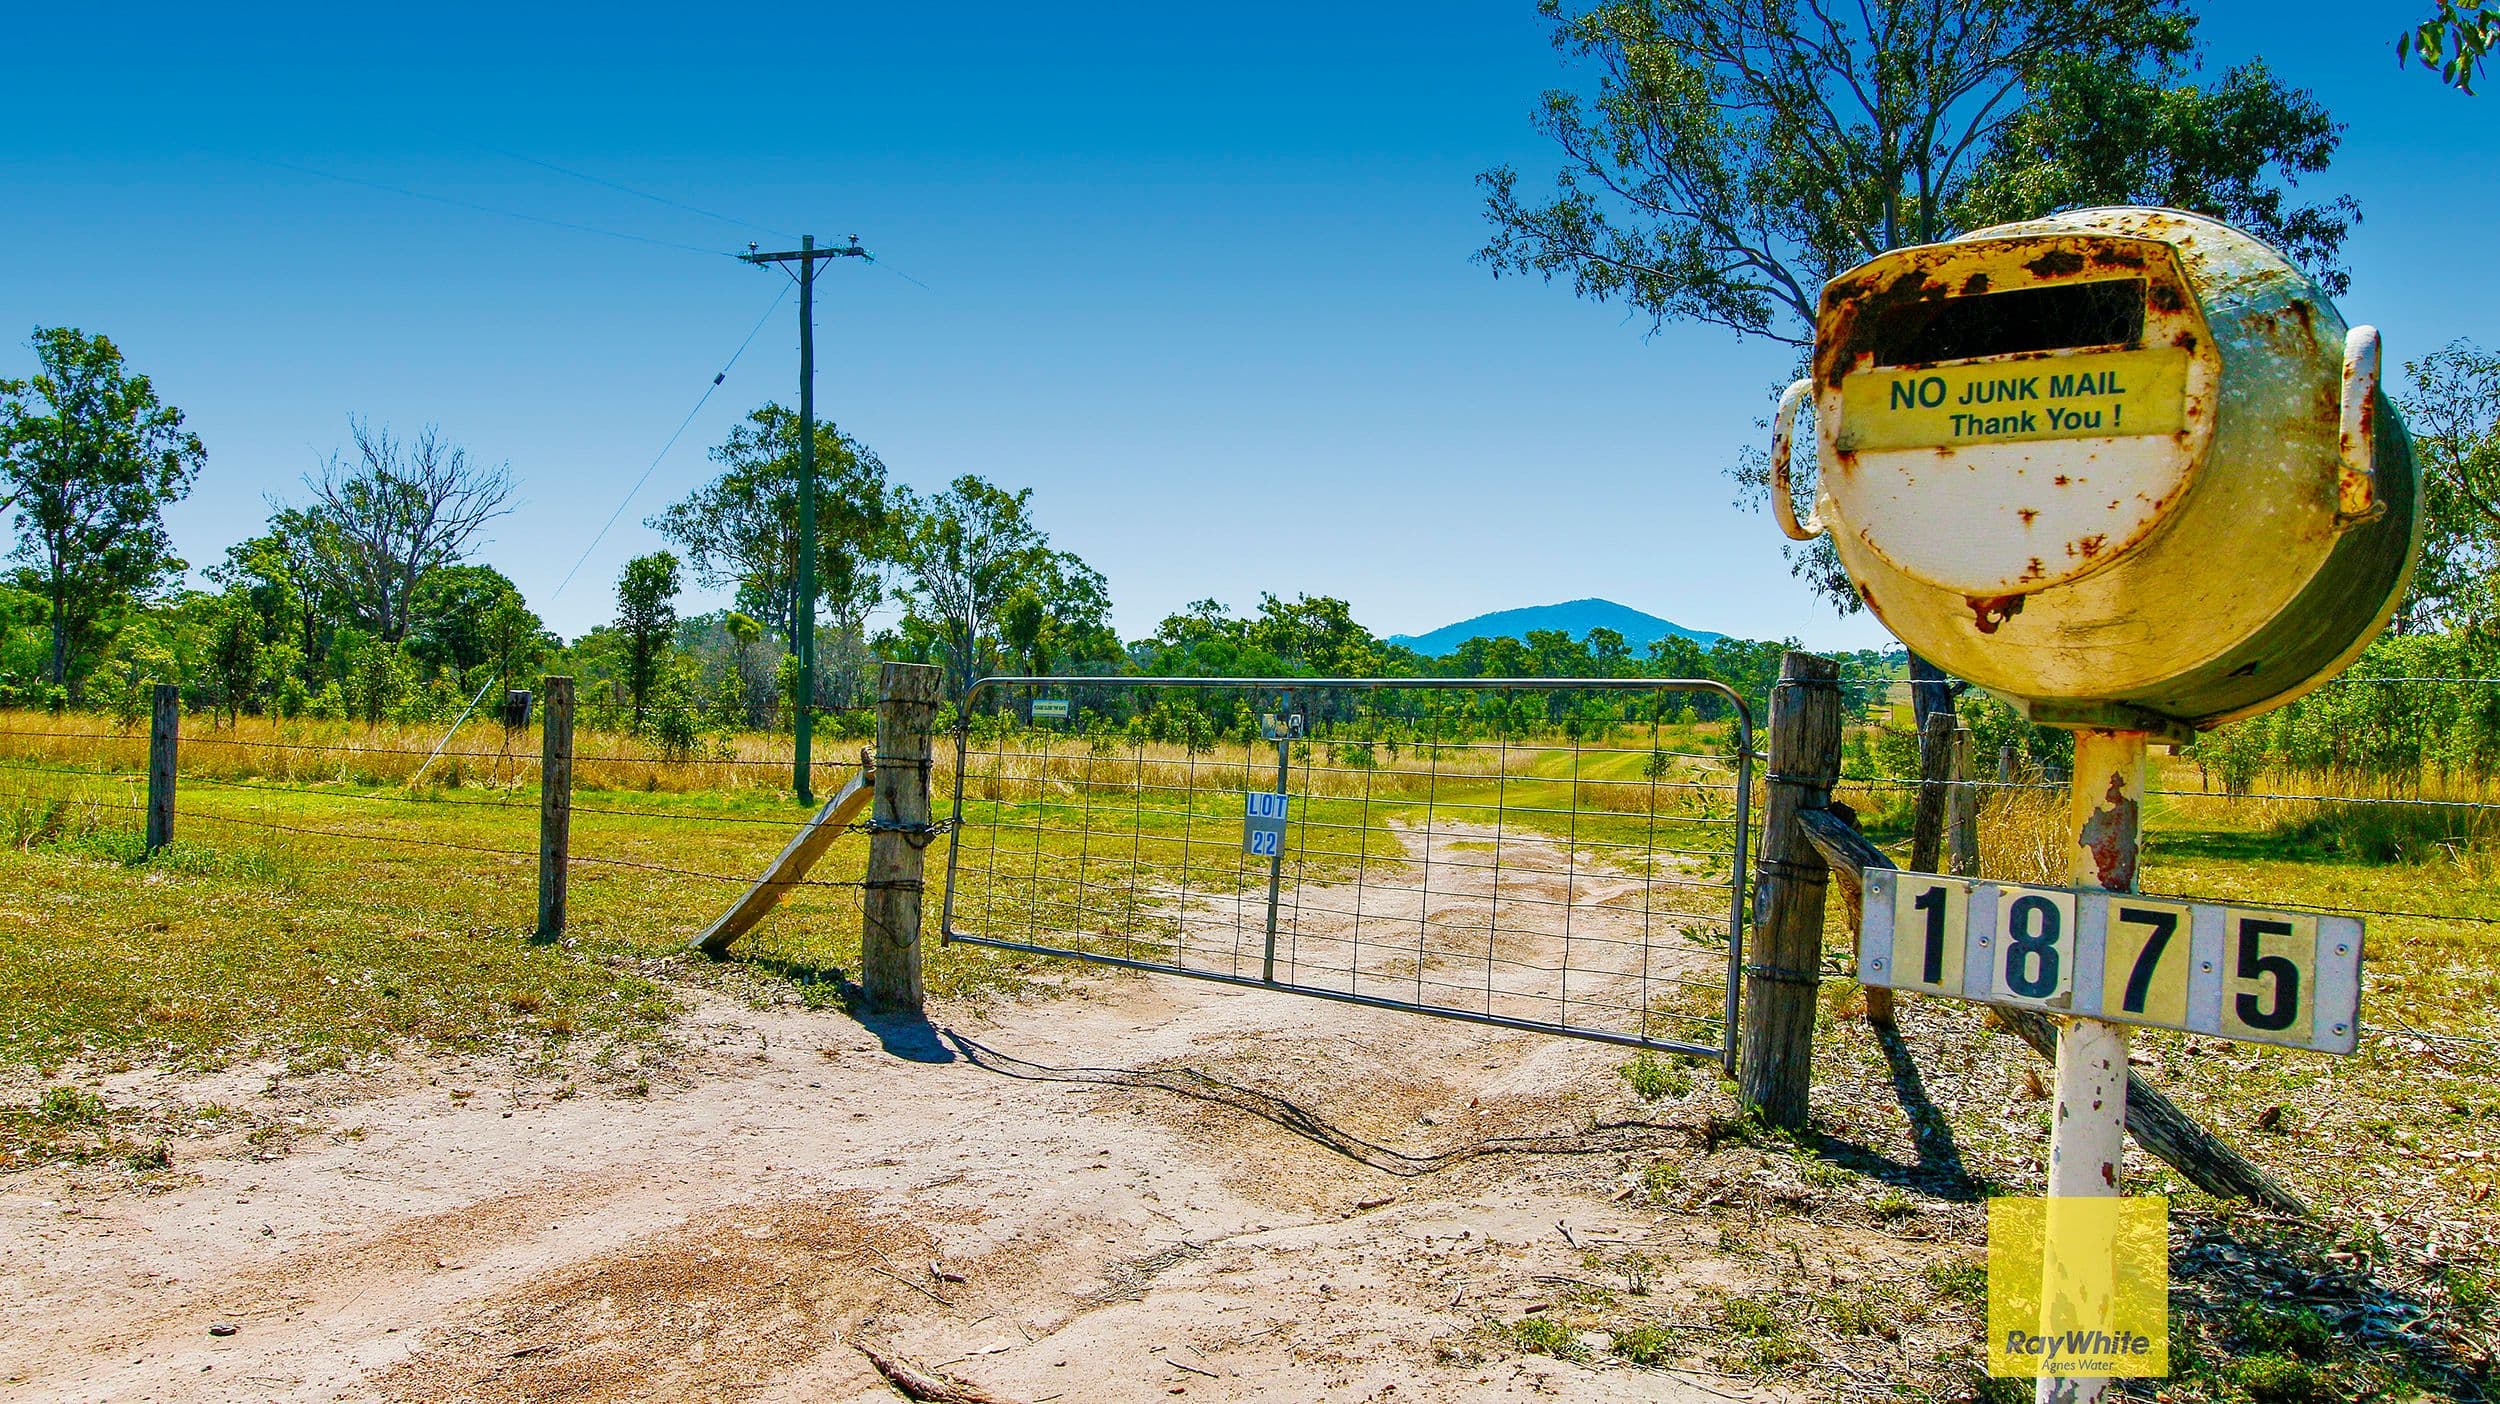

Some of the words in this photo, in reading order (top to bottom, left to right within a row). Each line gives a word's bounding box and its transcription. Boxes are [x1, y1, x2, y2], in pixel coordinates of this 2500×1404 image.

[1890, 376, 1947, 410] NO
[1958, 377, 2039, 405] JUNK
[2050, 371, 2126, 398] MAIL
[1949, 410, 2037, 437] Thank
[2046, 407, 2101, 431] You
[1249, 793, 1287, 818] LOT
[1252, 831, 1277, 855] 22
